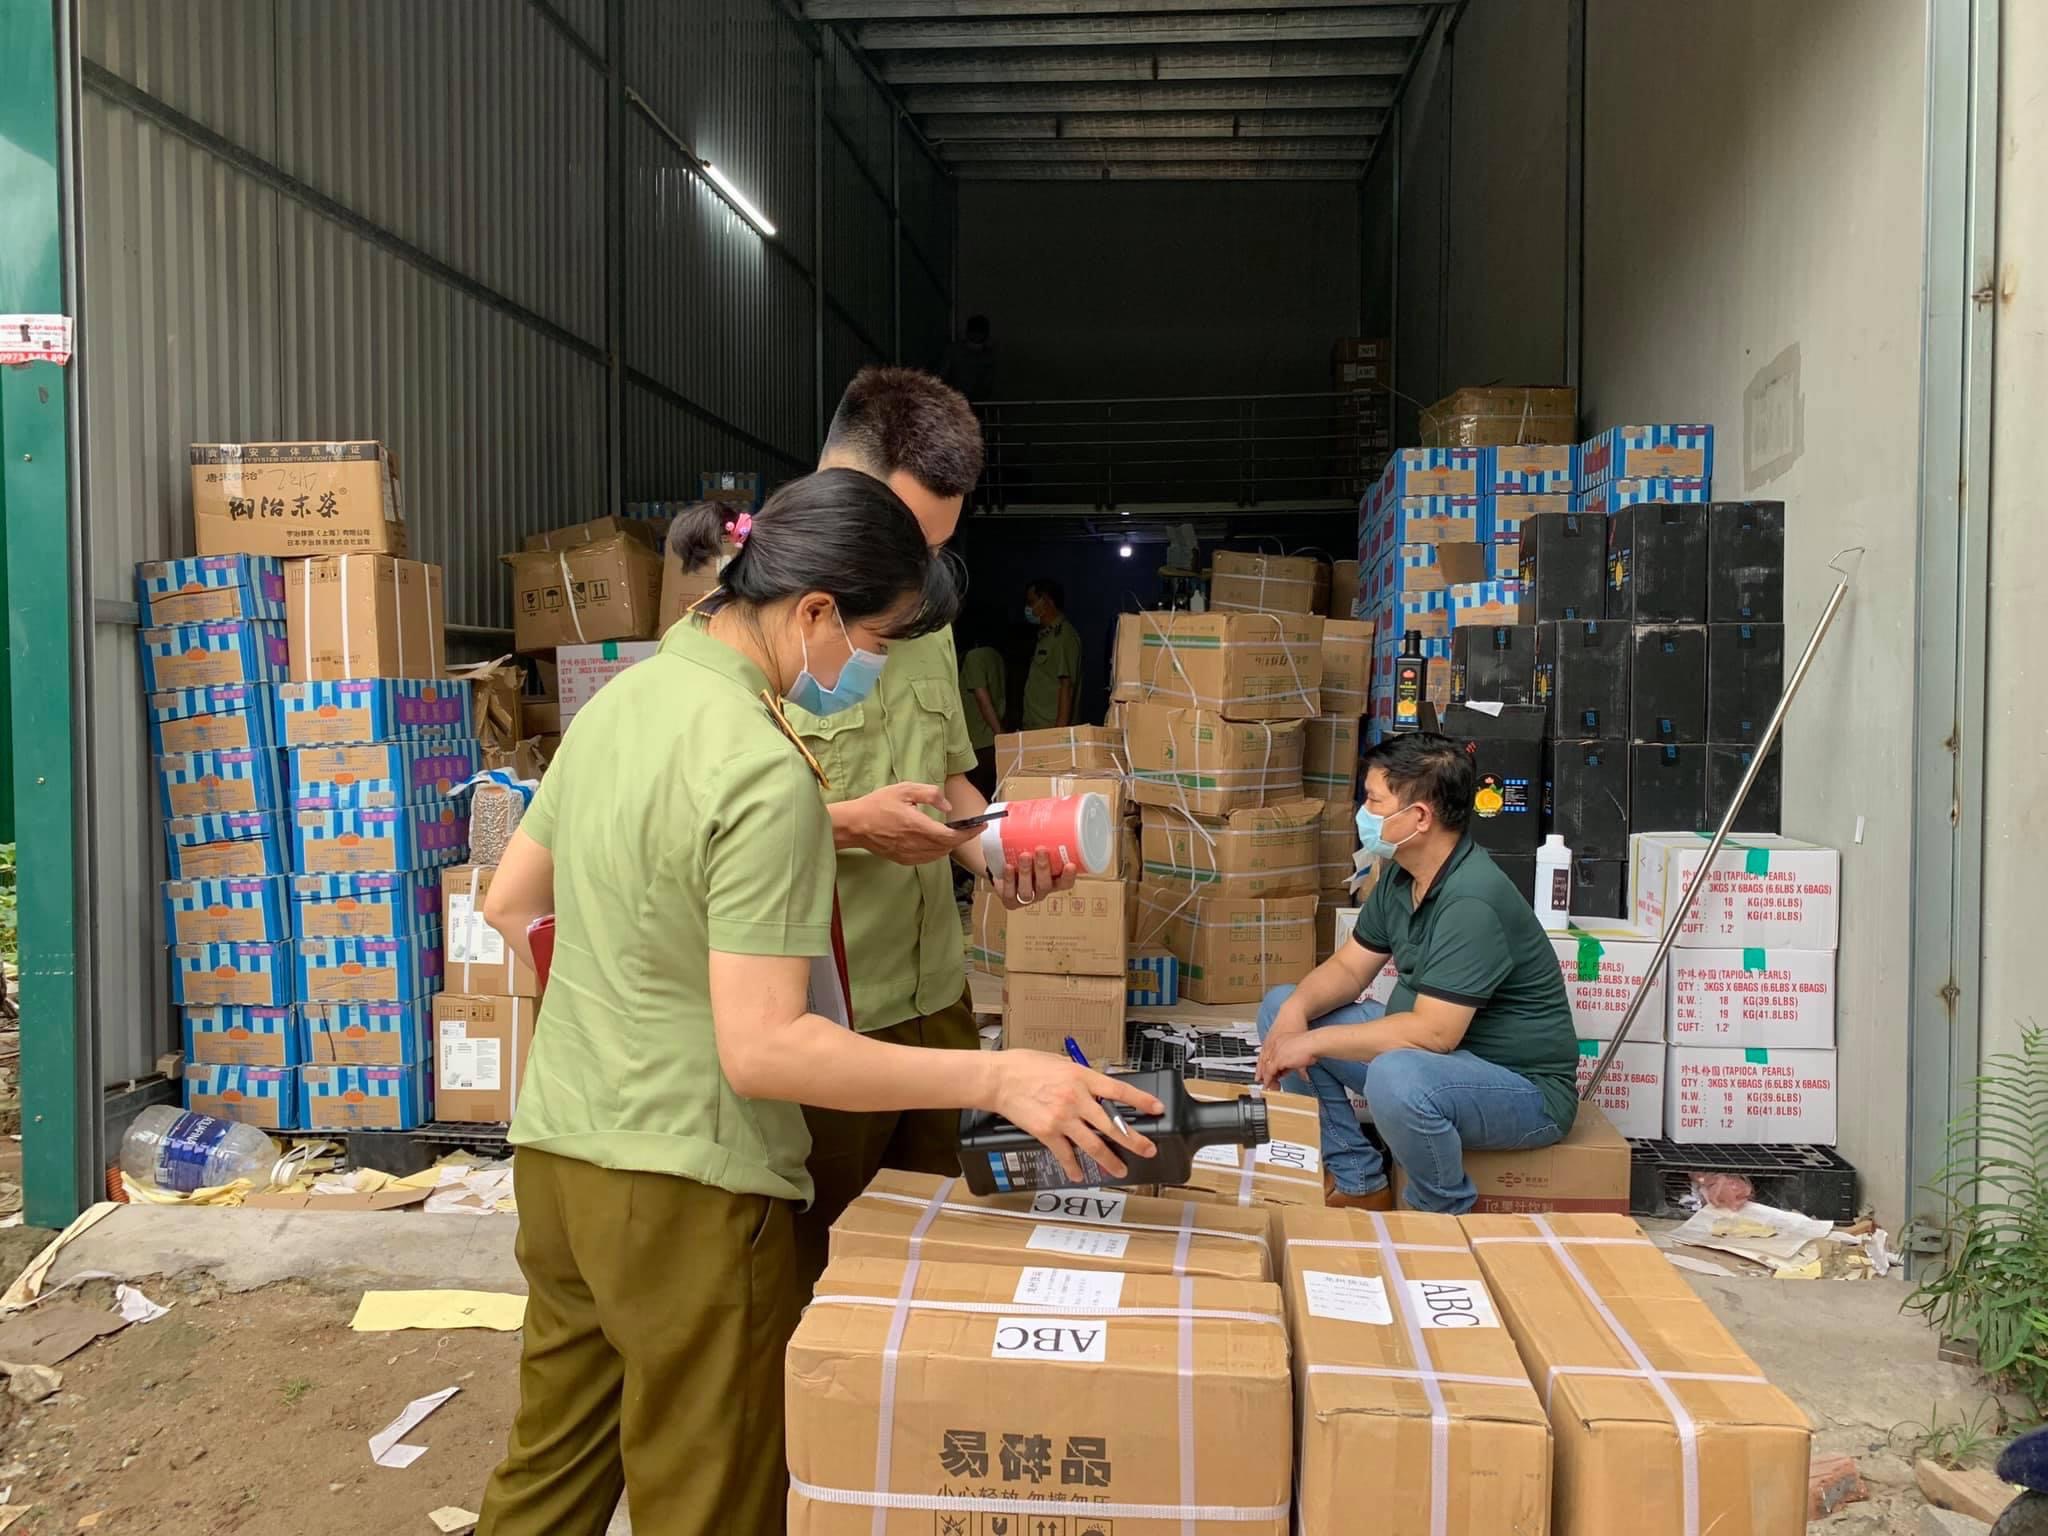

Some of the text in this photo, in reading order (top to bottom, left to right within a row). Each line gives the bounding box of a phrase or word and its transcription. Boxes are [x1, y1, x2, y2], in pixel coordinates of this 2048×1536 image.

[1723, 871, 1759, 882] (TAPIOCA
[1763, 872, 1796, 882] PEARLS)
[1709, 884, 1729, 894] 3KGS
[1731, 884, 1736, 893] X
[1738, 884, 1763, 894] 6BAGS
[1765, 884, 1794, 895] (6.6LBS
[1796, 884, 1801, 894] X
[1804, 885, 1832, 896] 6BAGS)
[1724, 897, 1733, 906] 18
[1747, 897, 1803, 908] KG(39.6LBS)
[1724, 910, 1733, 919] 19
[1747, 911, 1803, 921] KG(41.8LBS)
[1719, 969, 1754, 980] (TAPIOCA
[1758, 970, 1791, 981] PEARLS)
[1624, 975, 1630, 985] X
[1631, 976, 1659, 988] 6BS)
[1704, 982, 1724, 992] 3KGS
[1726, 983, 1731, 992] X
[1733, 983, 1759, 992] 6BAGS
[1761, 983, 1789, 993] (6.6LBS
[1792, 984, 1796, 993] X
[1799, 984, 1828, 993] 6BAGS)
[1576, 987, 1631, 999] KG(39.6LBS)
[1719, 996, 1729, 1005] 18
[1743, 996, 1799, 1007] KG(39.6LBS)
[1719, 1009, 1729, 1018] 19
[1743, 1009, 1799, 1020] KG(41.8LBS)
[1722, 1066, 1758, 1076] (TAPIOCA
[1762, 1066, 1795, 1077] PEARLS)
[1625, 1073, 1629, 1082] X
[1631, 1074, 1658, 1085] 6BAGS)
[1707, 1079, 1728, 1088] 3KGS
[1730, 1079, 1735, 1088] X
[1737, 1079, 1763, 1089] 6BAGS
[1764, 1079, 1793, 1089] (6.6LBS
[1795, 1080, 1800, 1089] X
[1802, 1080, 1831, 1090] 6BAGS)
[1723, 1092, 1733, 1101] 18
[1746, 1092, 1802, 1104] KG(39.6LBS)
[1723, 1105, 1733, 1114] 19
[1746, 1106, 1802, 1117] KG(41.8LBS)
[186, 1115, 216, 1145] AQUAFINA
[1269, 1140, 1306, 1169] ABC
[1034, 1193, 1121, 1219] ABC
[1420, 1282, 1480, 1327] ABC
[996, 1326, 1101, 1353] ABC
[938, 1429, 1112, 1487] 易碎品
